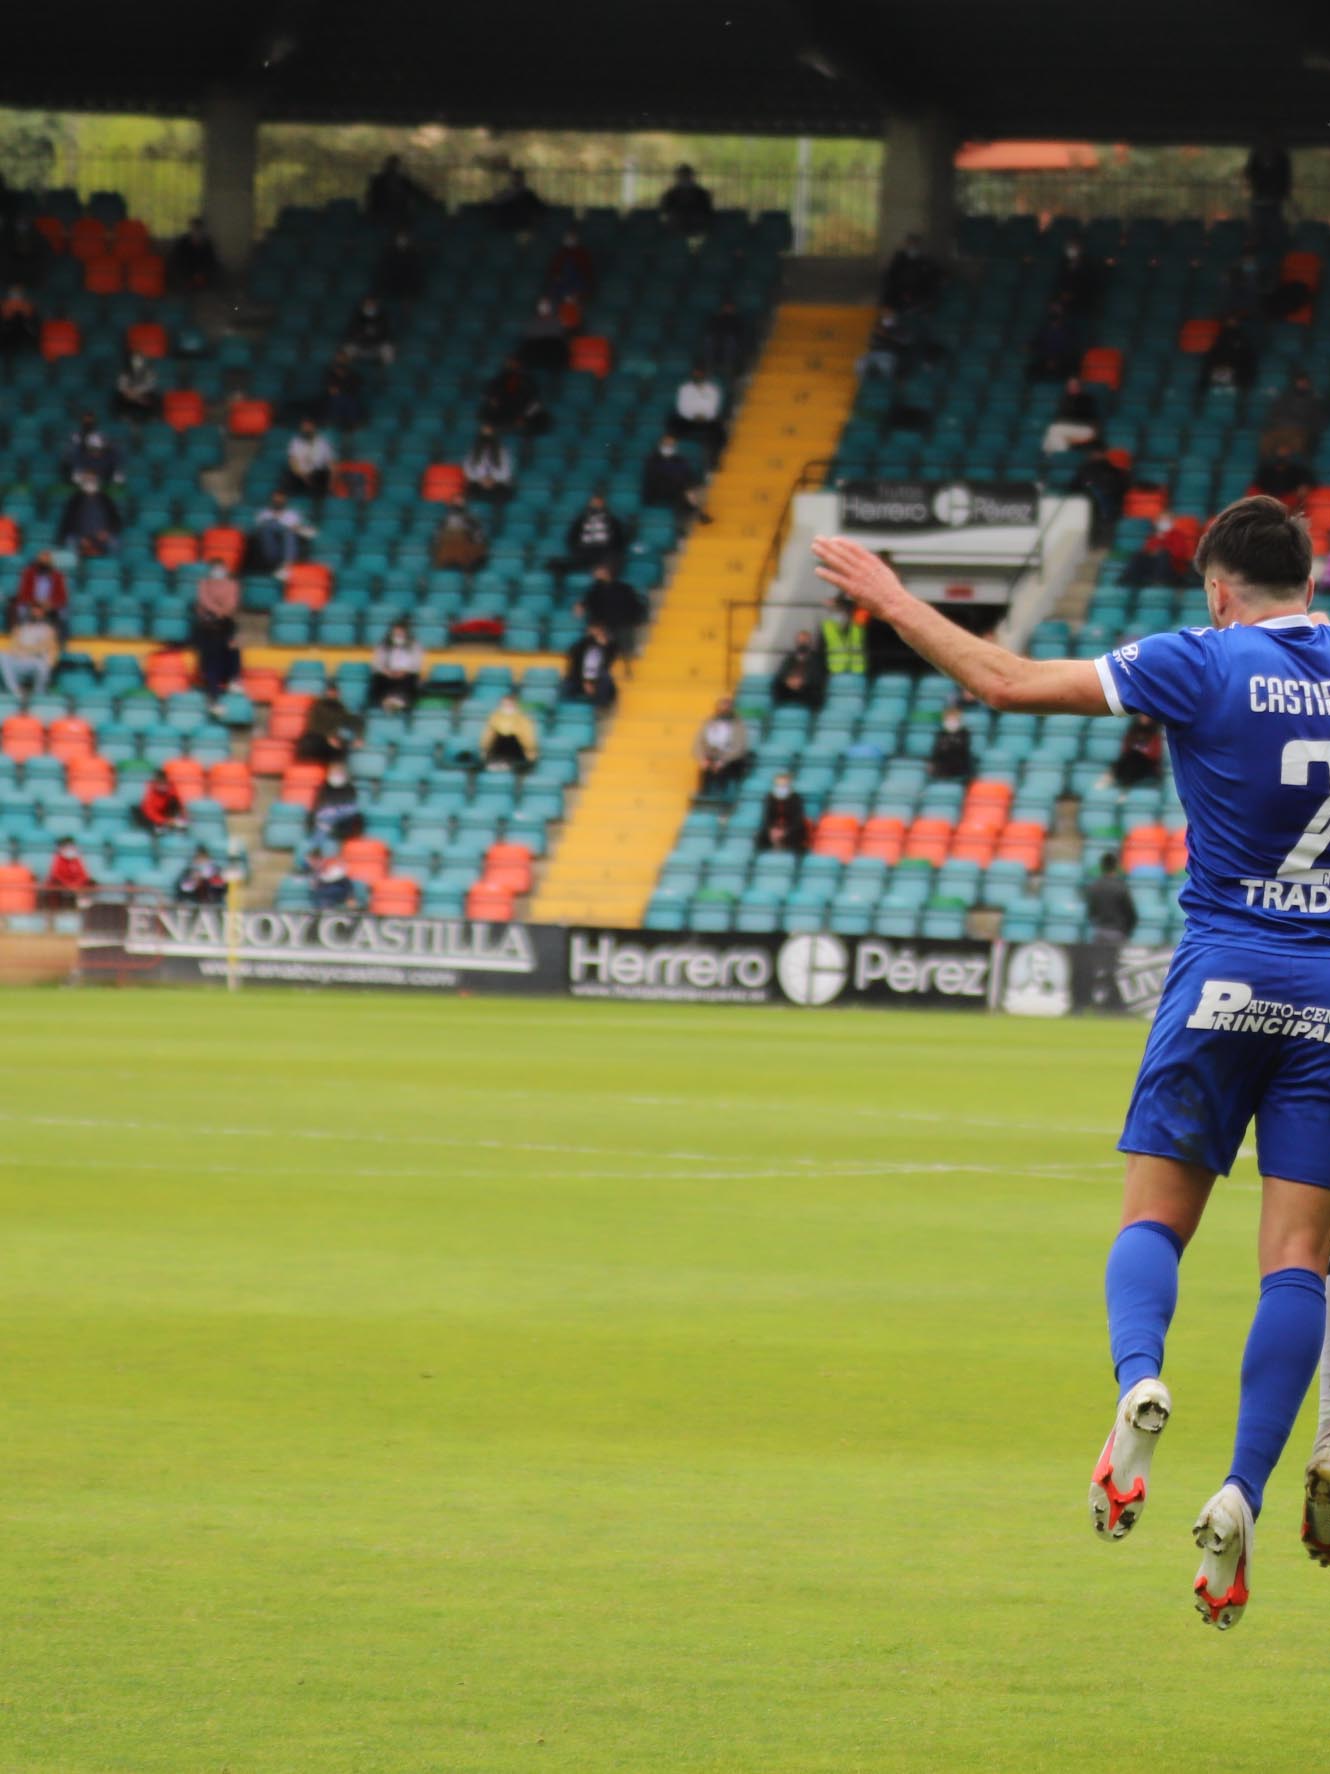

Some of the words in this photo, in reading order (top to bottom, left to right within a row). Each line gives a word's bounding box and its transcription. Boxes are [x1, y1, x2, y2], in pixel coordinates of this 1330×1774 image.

[317, 911, 535, 960] CASTILLA
[570, 934, 770, 988] Herrero
[855, 940, 986, 997] Pérez
